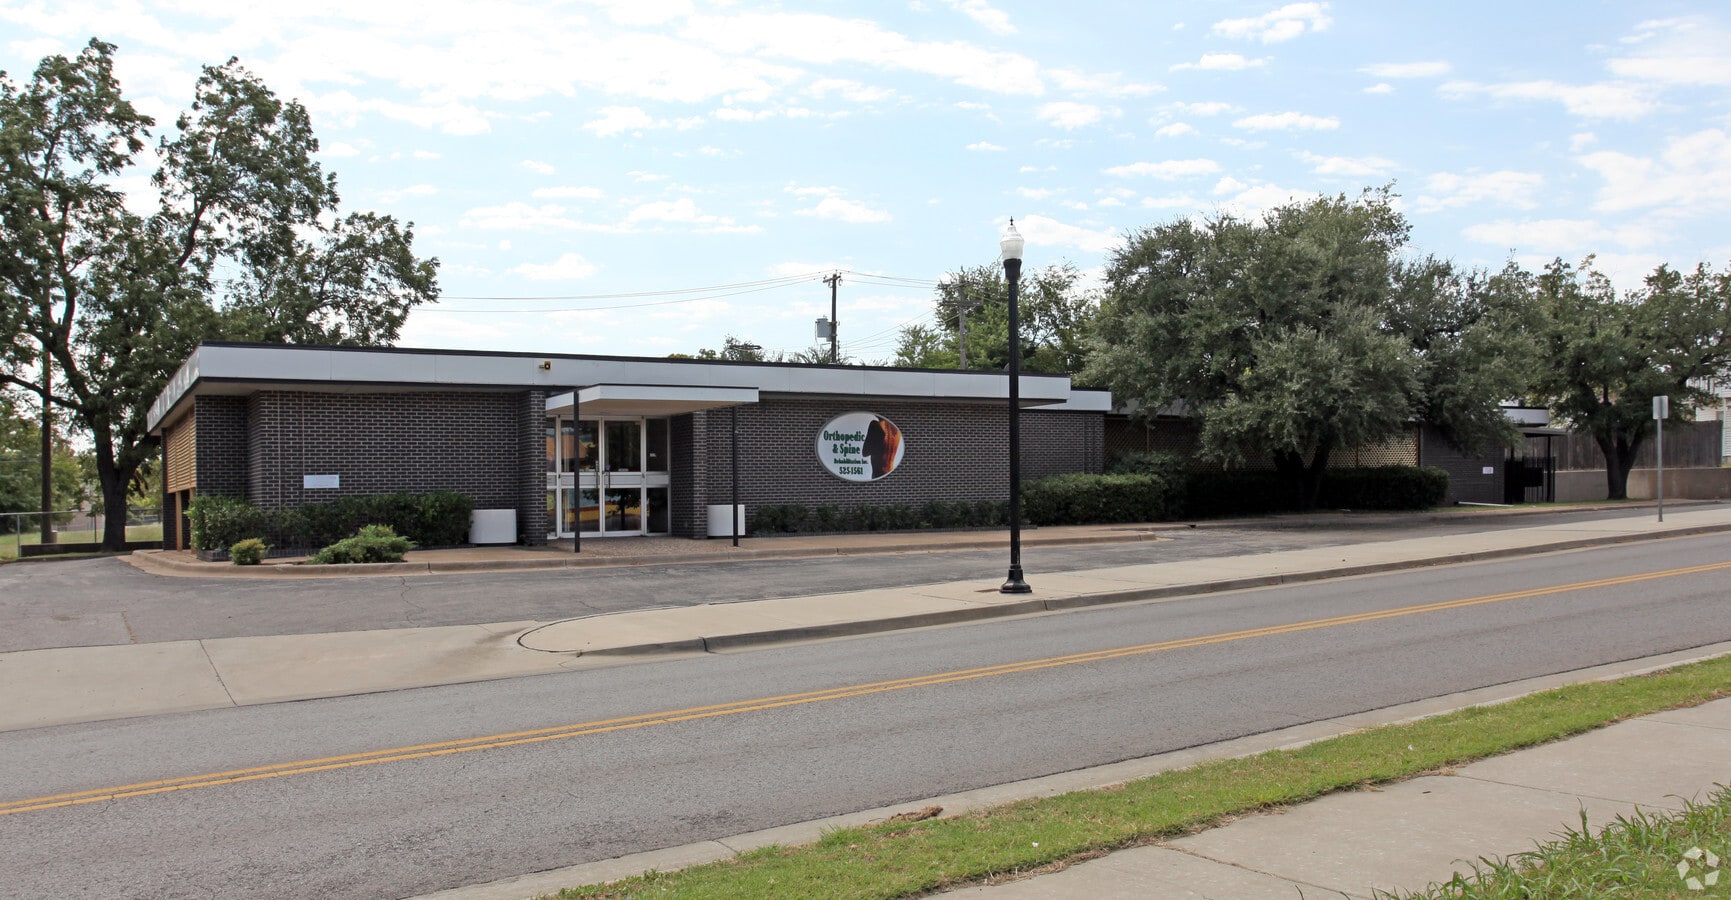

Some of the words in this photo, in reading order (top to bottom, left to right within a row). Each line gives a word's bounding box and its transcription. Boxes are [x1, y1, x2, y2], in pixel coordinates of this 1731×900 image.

[823, 430, 865, 444] Orthopedic
[832, 444, 839, 454] &
[839, 443, 861, 457] Spine
